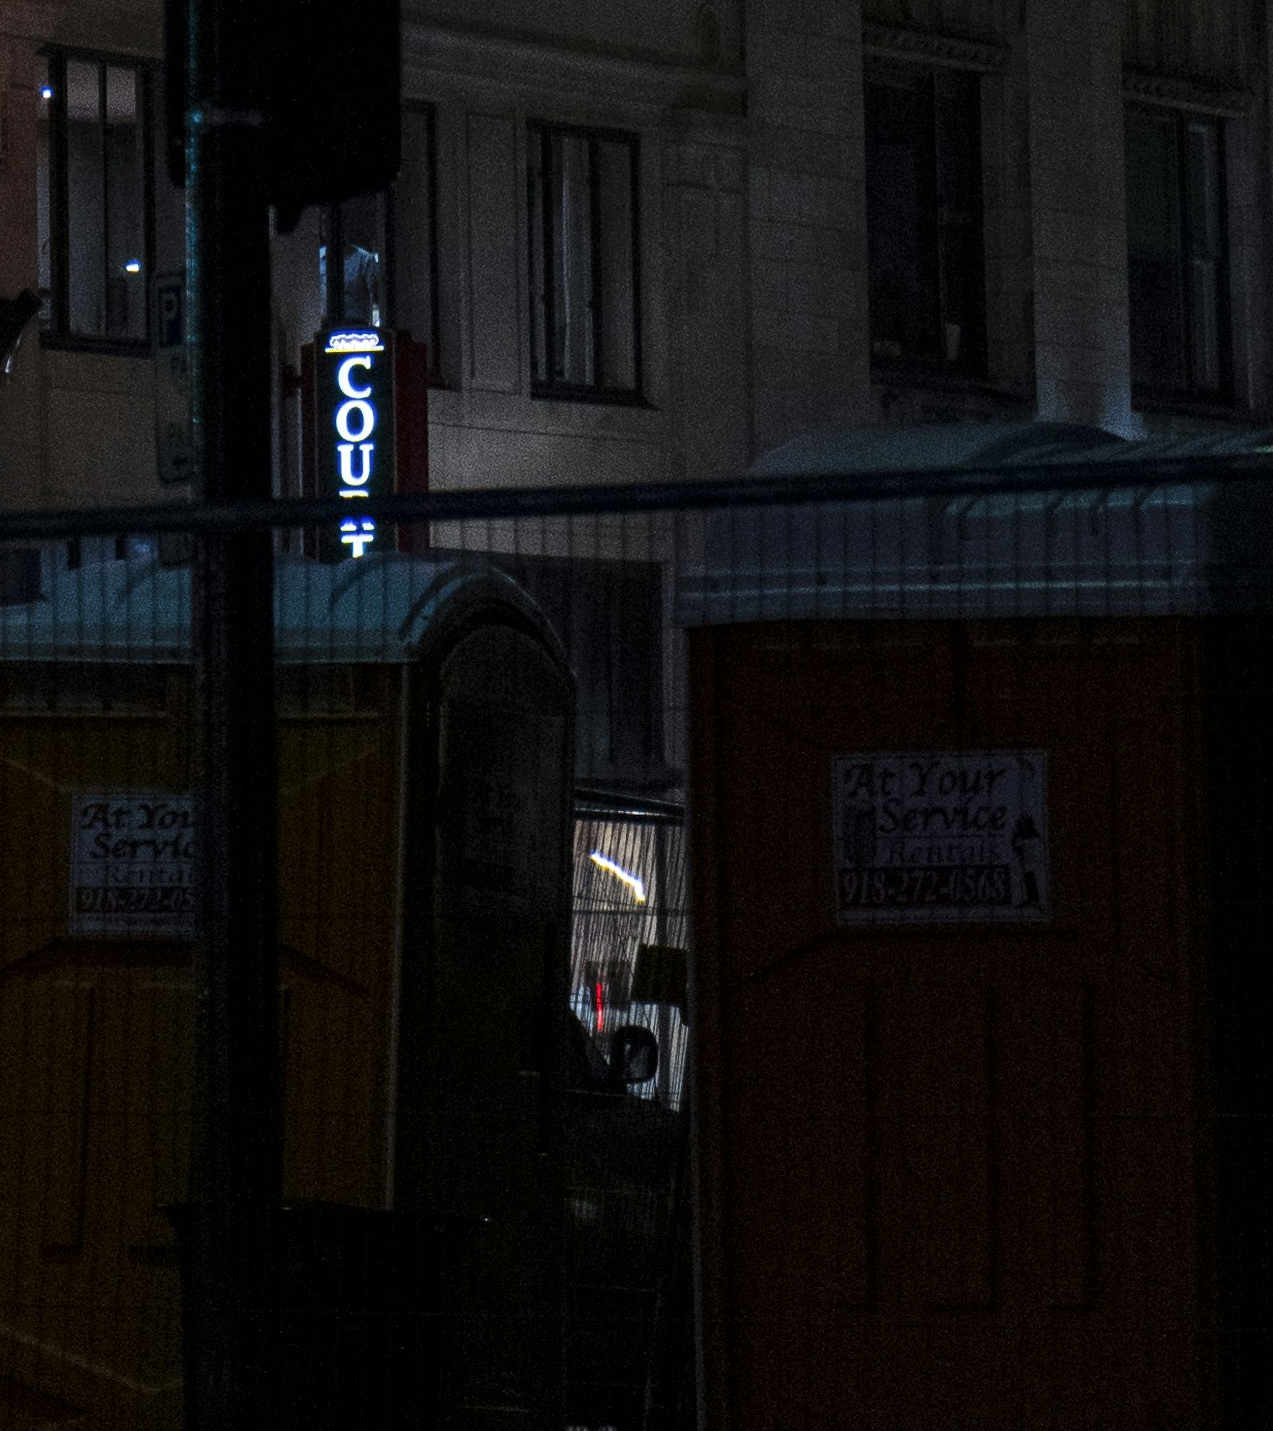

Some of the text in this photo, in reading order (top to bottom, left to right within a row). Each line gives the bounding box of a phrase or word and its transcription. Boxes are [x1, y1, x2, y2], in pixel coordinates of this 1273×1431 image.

[844, 760, 1006, 797] At Your
[81, 803, 131, 829] At
[879, 798, 1007, 833] Service
